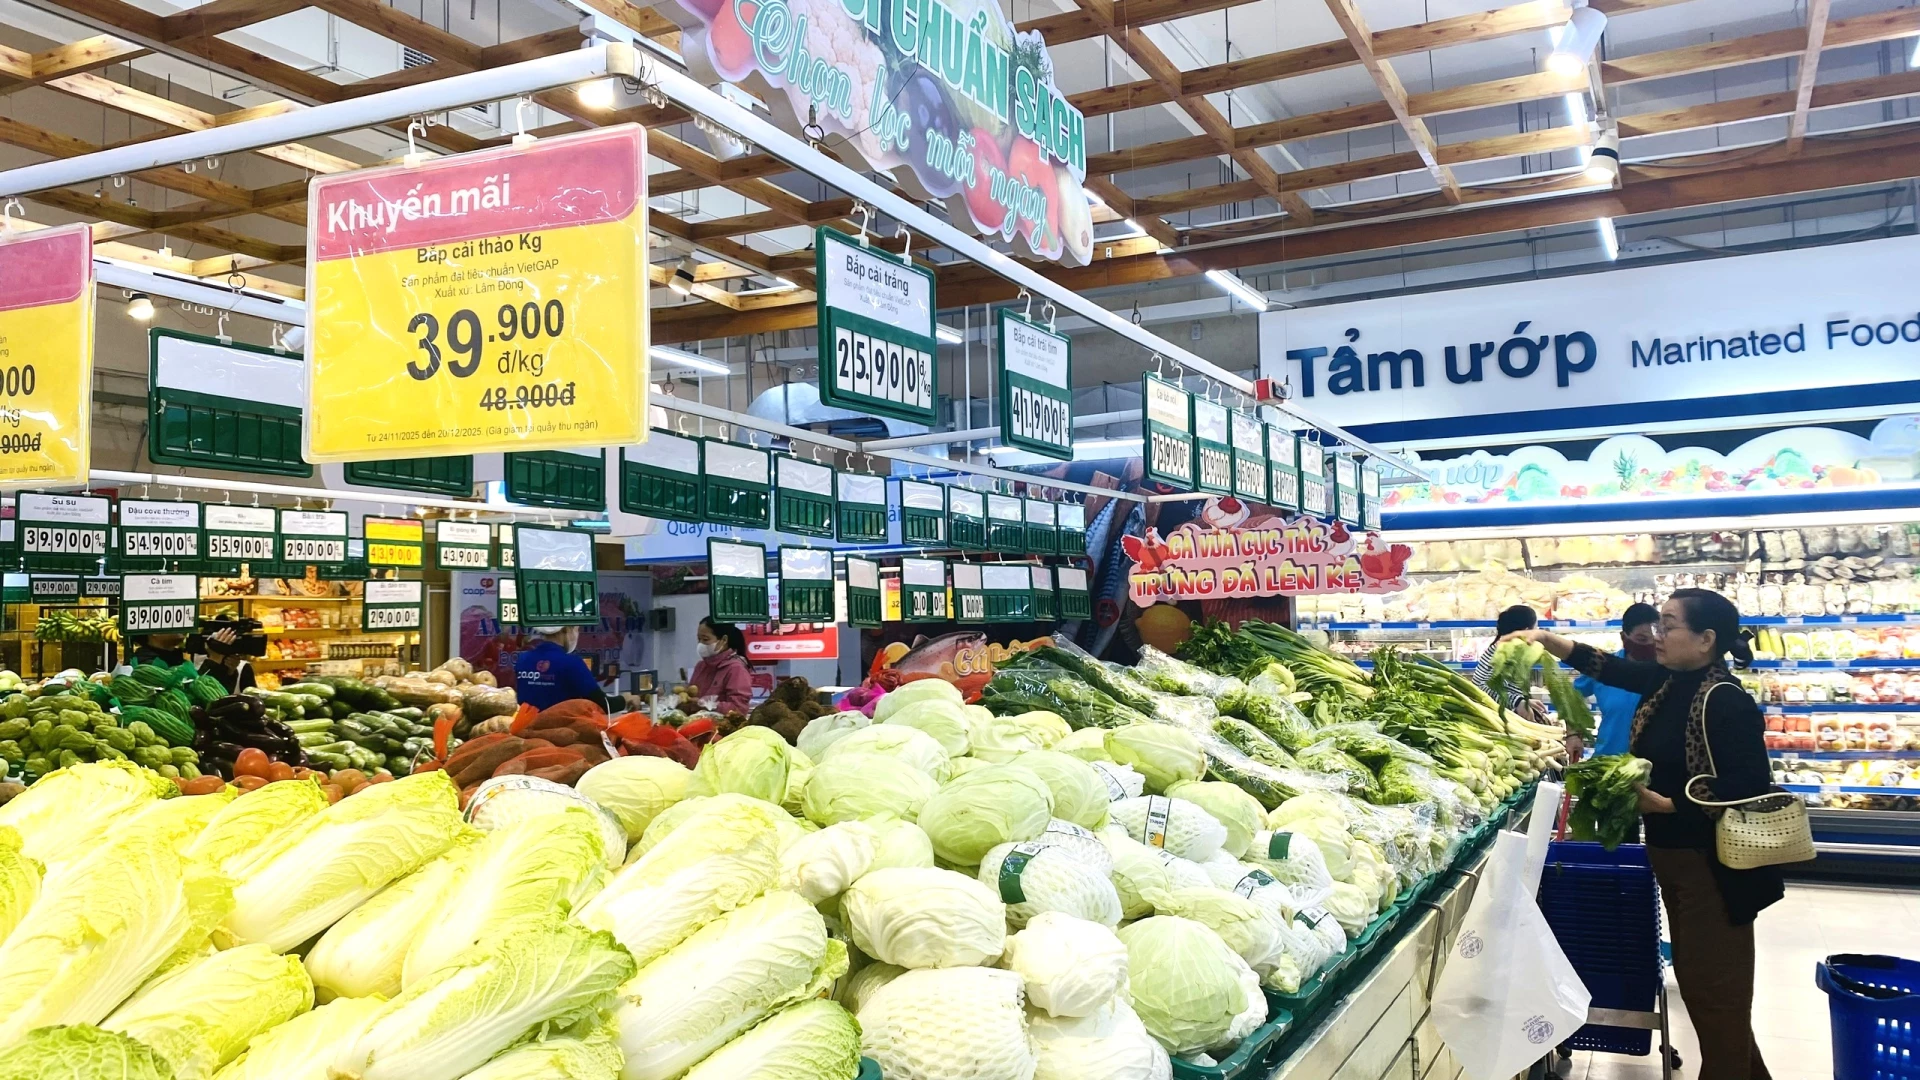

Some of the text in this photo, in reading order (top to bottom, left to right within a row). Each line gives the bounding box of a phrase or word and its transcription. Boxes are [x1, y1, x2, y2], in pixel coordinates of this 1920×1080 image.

[894, 0, 1010, 124] CHUẨN
[1015, 65, 1086, 171] SẠCH
[734, 0, 1046, 249] Chọn lọc mỗi ngày
[327, 174, 510, 234] Khuyến mãi
[417, 233, 542, 264] Bắp cải thảo Kg
[517, 258, 559, 274] VietGAP
[846, 254, 909, 297] Bắp cải trắng
[475, 281, 495, 294] Lâm
[1631, 323, 1806, 368] Marinated
[498, 351, 544, 377] đ/kg
[838, 337, 916, 394] 25.900
[1286, 320, 1599, 399] Tẩm ướp
[479, 382, 576, 412] 48.900đ
[1012, 391, 1059, 437] 41.900
[378, 431, 420, 442] 24/11/2025
[558, 421, 571, 431] thu
[26, 529, 91, 548] 39.900
[128, 535, 185, 551] 54.900
[211, 538, 261, 553] 55.900
[287, 543, 334, 556] 29.000
[1168, 529, 1193, 561] GÀ
[1241, 530, 1283, 562] CỤC
[1285, 525, 1323, 554] TÁC
[371, 546, 412, 560] 43.900
[443, 550, 479, 563] 43.900
[34, 581, 70, 592] 49.900
[87, 581, 120, 592] 29.900
[1130, 556, 1362, 598] TRỨNG ĐÃ LÊN KỆ
[129, 609, 183, 625] 39.000
[371, 610, 411, 624] 29.000
[954, 648, 988, 676] Cá
